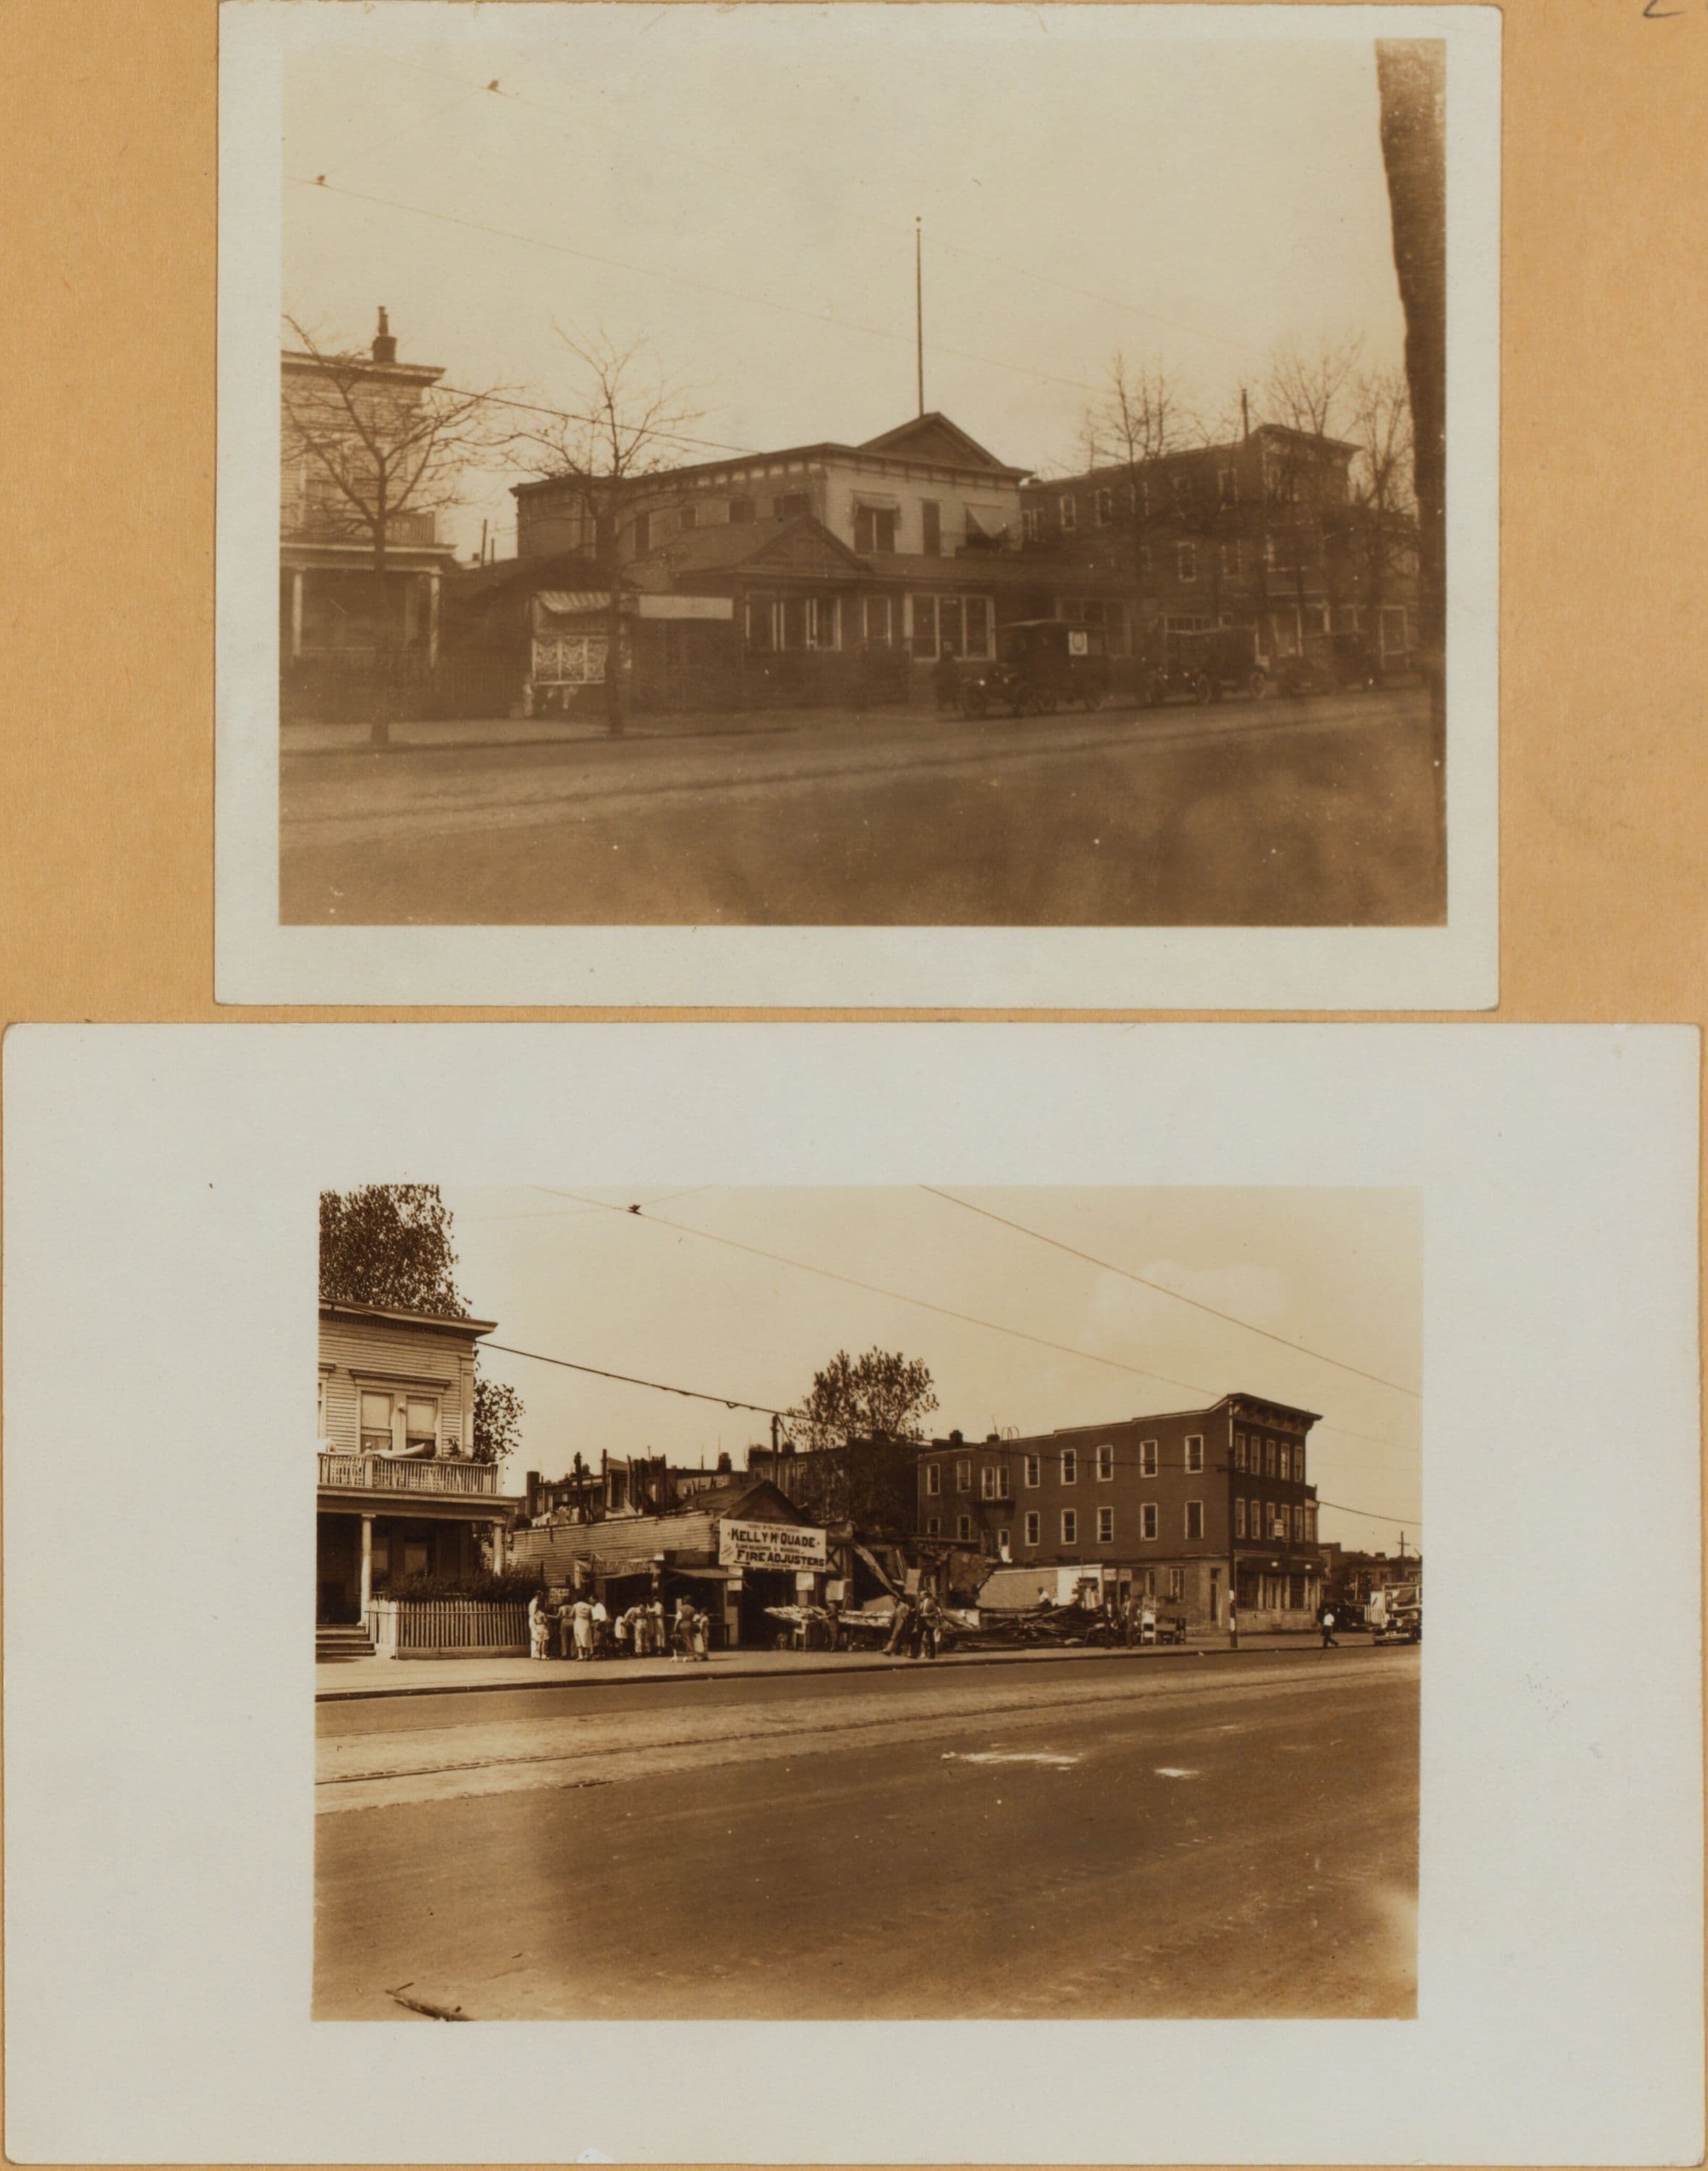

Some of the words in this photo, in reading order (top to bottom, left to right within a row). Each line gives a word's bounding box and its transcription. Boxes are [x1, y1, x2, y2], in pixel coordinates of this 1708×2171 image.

[731, 1528, 768, 1543] KELLY
[737, 1549, 765, 1562] FIRE
[767, 1552, 824, 1567] ADJUSTERS
